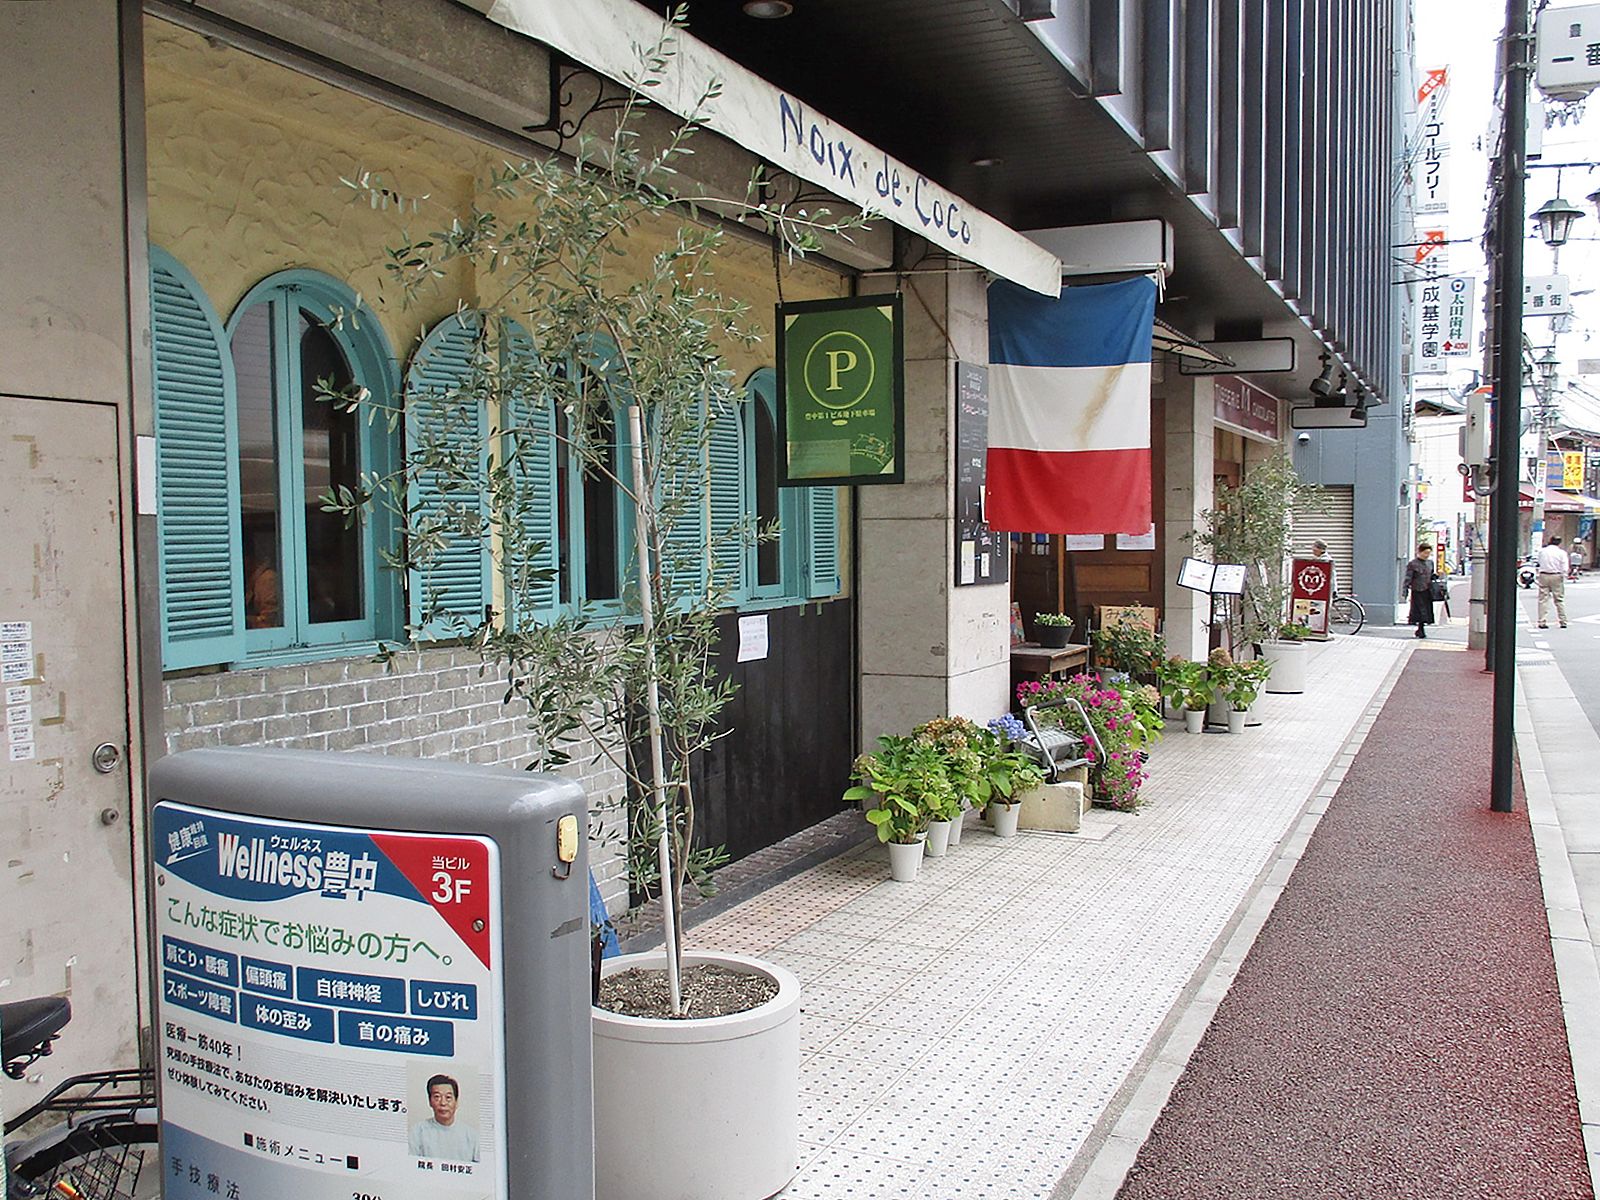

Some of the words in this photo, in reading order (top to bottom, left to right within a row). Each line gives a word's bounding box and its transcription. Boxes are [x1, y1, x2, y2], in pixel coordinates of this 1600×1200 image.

[779, 94, 856, 188] Noix
[876, 155, 902, 207] de
[1425, 122, 1444, 199] ゴールフリー
[1421, 285, 1440, 358] 成基学園
[1449, 294, 1465, 340] 太田歯科
[825, 350, 858, 391] P
[168, 827, 193, 853] 健康
[271, 834, 322, 853] ウェルネス
[432, 856, 471, 870] 当ビル
[432, 872, 472, 904] 3F
[168, 897, 453, 966] こんな症状でお悩みの方へ。
[166, 943, 229, 978] 肩こり・腰痛
[246, 965, 288, 991] 偏頭痛
[317, 978, 382, 1004] 自律神経
[166, 979, 232, 1015] スポーツ障害
[417, 989, 469, 1011] しびれ
[255, 1003, 312, 1031] 体の歪み
[358, 1021, 430, 1047] 首の痛み
[171, 1156, 241, 1200] 手技療法
